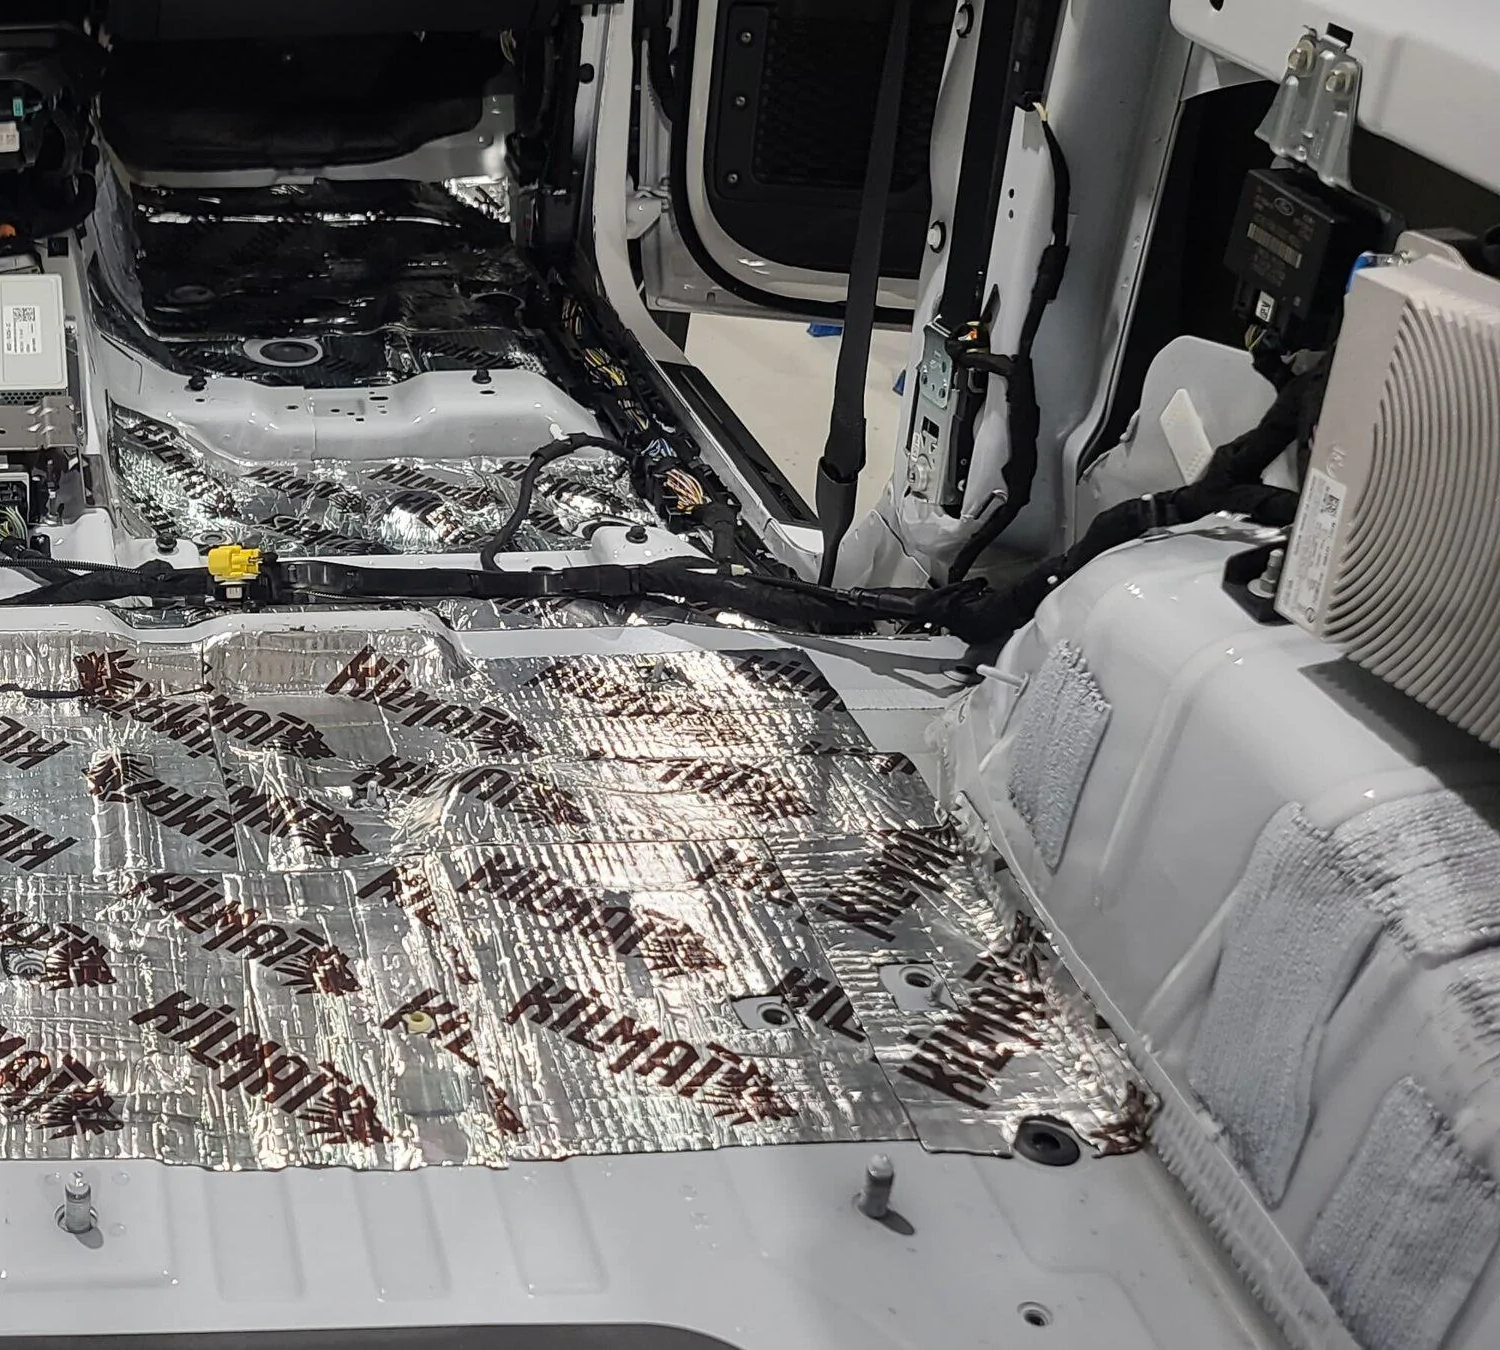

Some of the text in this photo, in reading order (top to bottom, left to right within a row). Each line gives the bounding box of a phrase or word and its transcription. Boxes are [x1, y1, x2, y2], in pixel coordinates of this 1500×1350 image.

[325, 644, 509, 741] KILMAT
[122, 872, 328, 968] KILMAT
[128, 990, 353, 1115] KILMAT
[505, 976, 744, 1097] KILMAT
[897, 952, 1049, 1111] KILMAT
